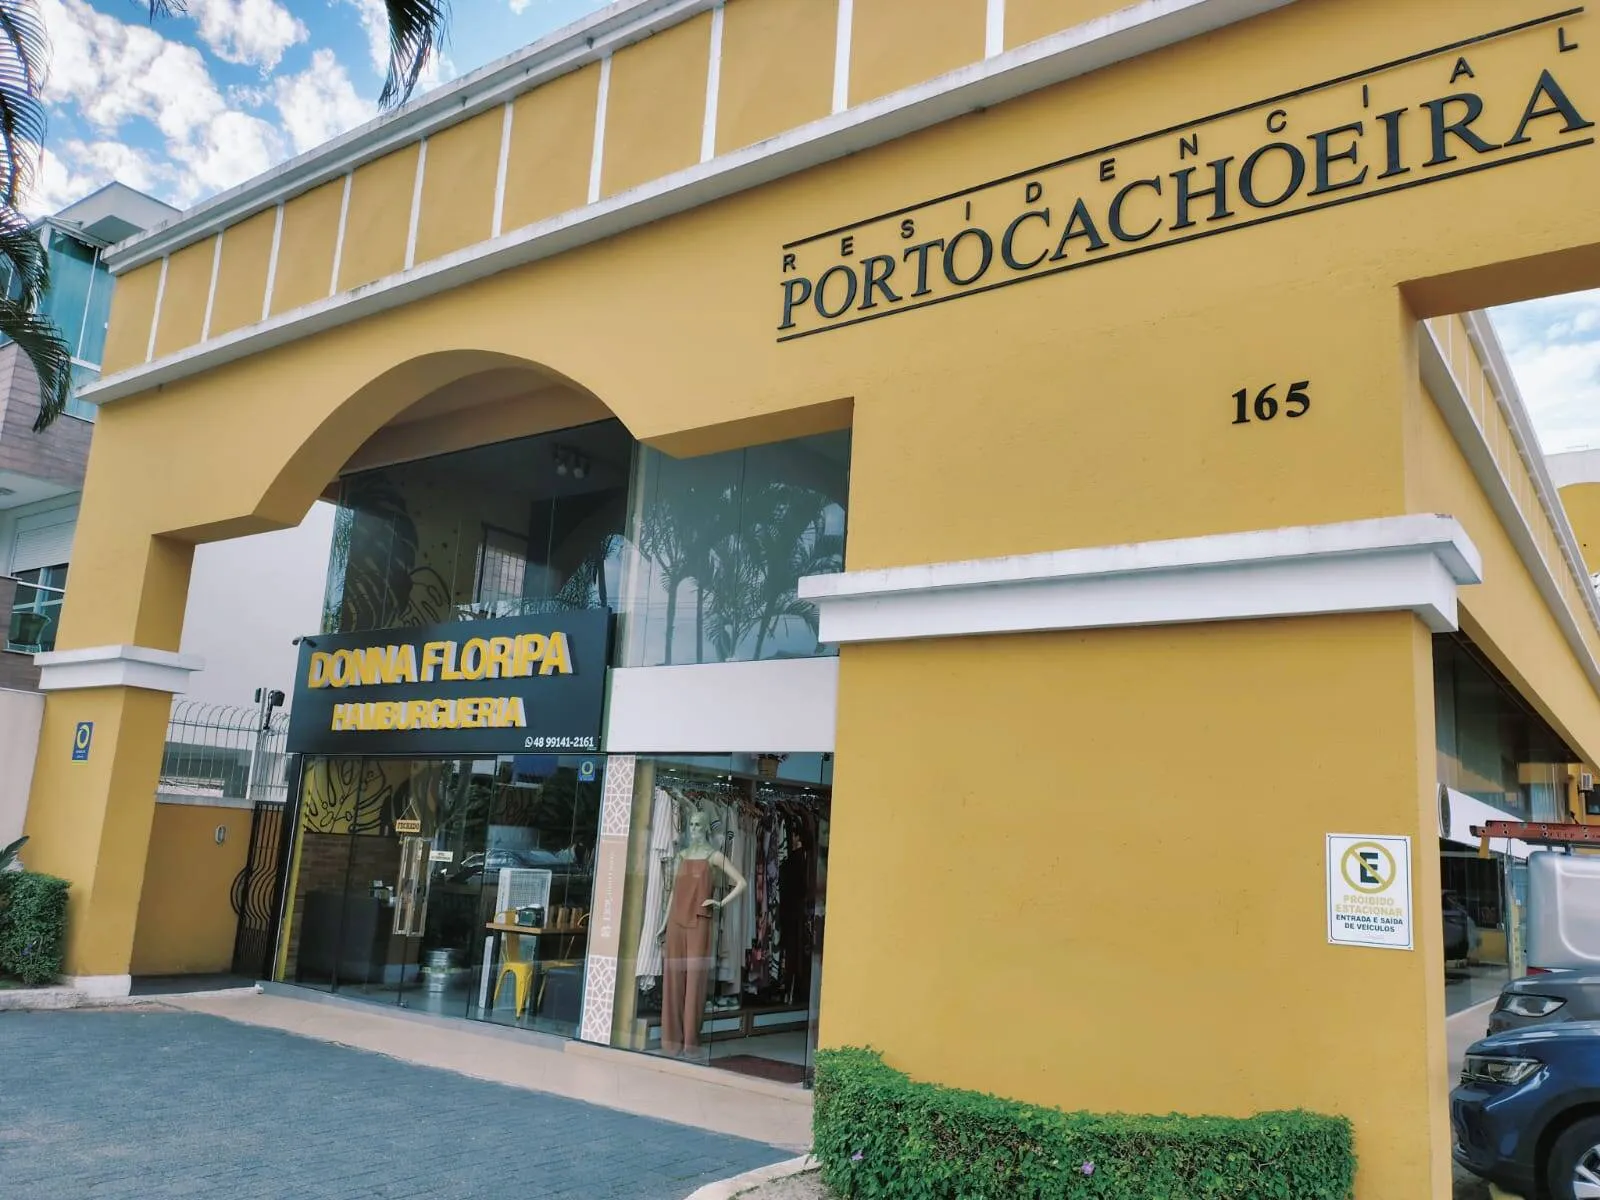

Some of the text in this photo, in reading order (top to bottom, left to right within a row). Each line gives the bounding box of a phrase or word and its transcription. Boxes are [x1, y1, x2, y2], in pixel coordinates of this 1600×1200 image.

[782, 27, 1579, 273] RESIDENCIAL
[1231, 380, 1310, 425] 165
[308, 631, 573, 688] DONNA FLORIPA
[331, 697, 527, 731] HAMBURGUERIA
[533, 736, 594, 747] 48 99141-2161
[1359, 852, 1380, 883] E
[1336, 904, 1402, 916] ESTACIONAR
[1344, 895, 1394, 906] PROIBIDO
[1336, 914, 1371, 923] ENTRADA
[1344, 922, 1355, 930] DE
